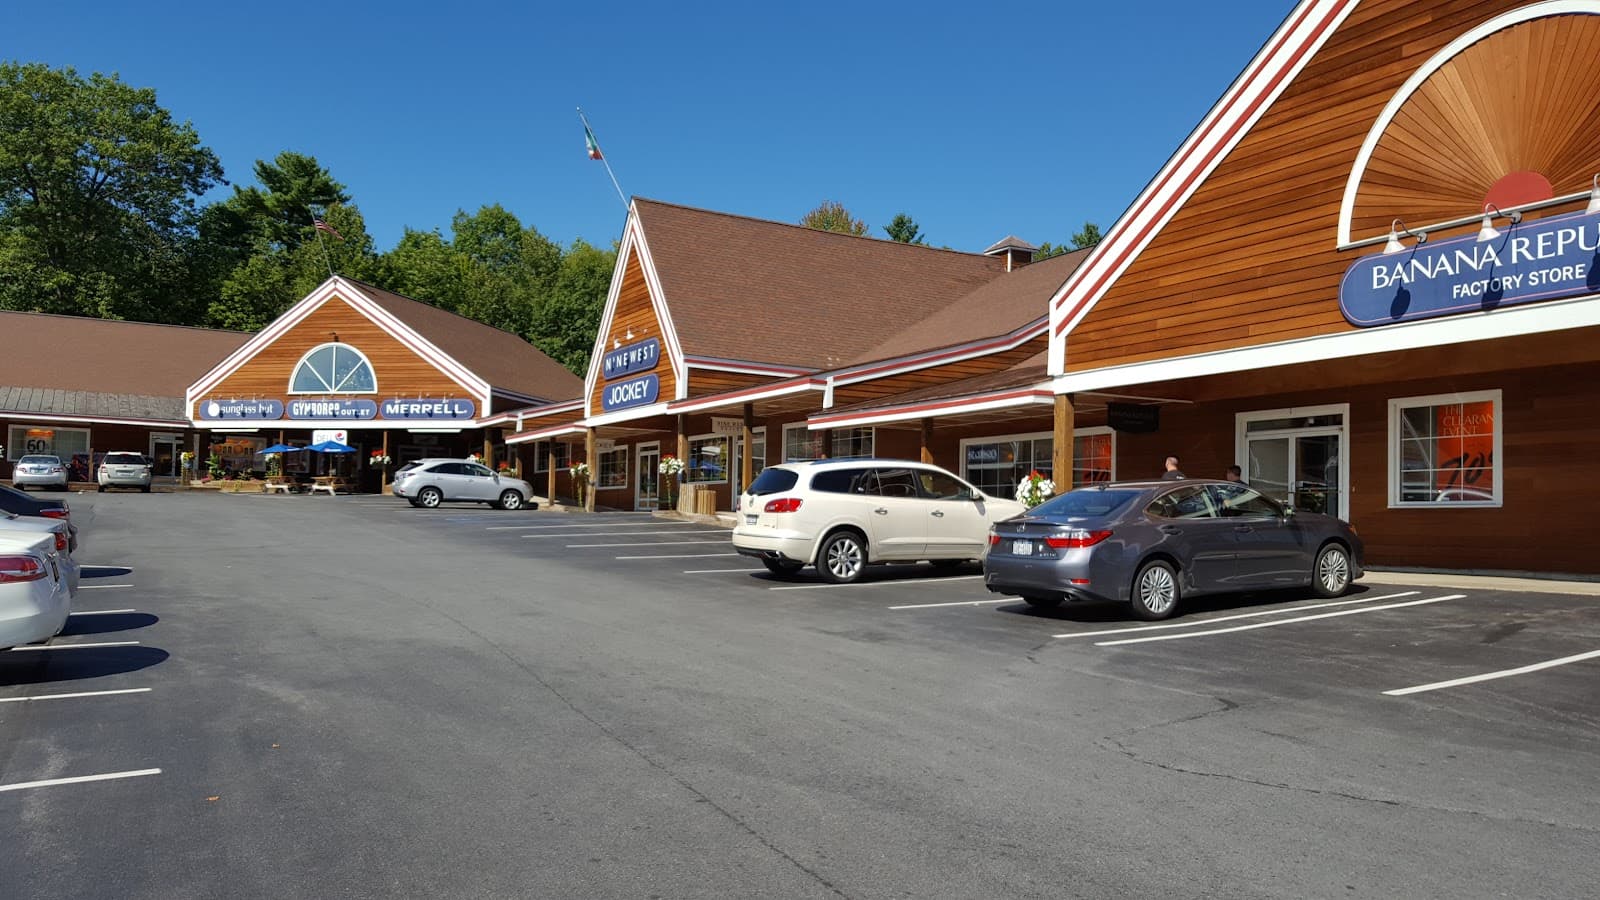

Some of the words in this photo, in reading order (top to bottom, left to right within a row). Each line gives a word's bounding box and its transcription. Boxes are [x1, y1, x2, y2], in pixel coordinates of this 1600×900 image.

[1372, 244, 1503, 289] BANANA
[1453, 273, 1524, 299] FACTORY
[1528, 263, 1586, 286] STORE
[629, 344, 655, 364] WEST
[608, 379, 649, 406] JOCKEY
[221, 403, 256, 416] sunglass
[386, 403, 463, 414] MERRELL
